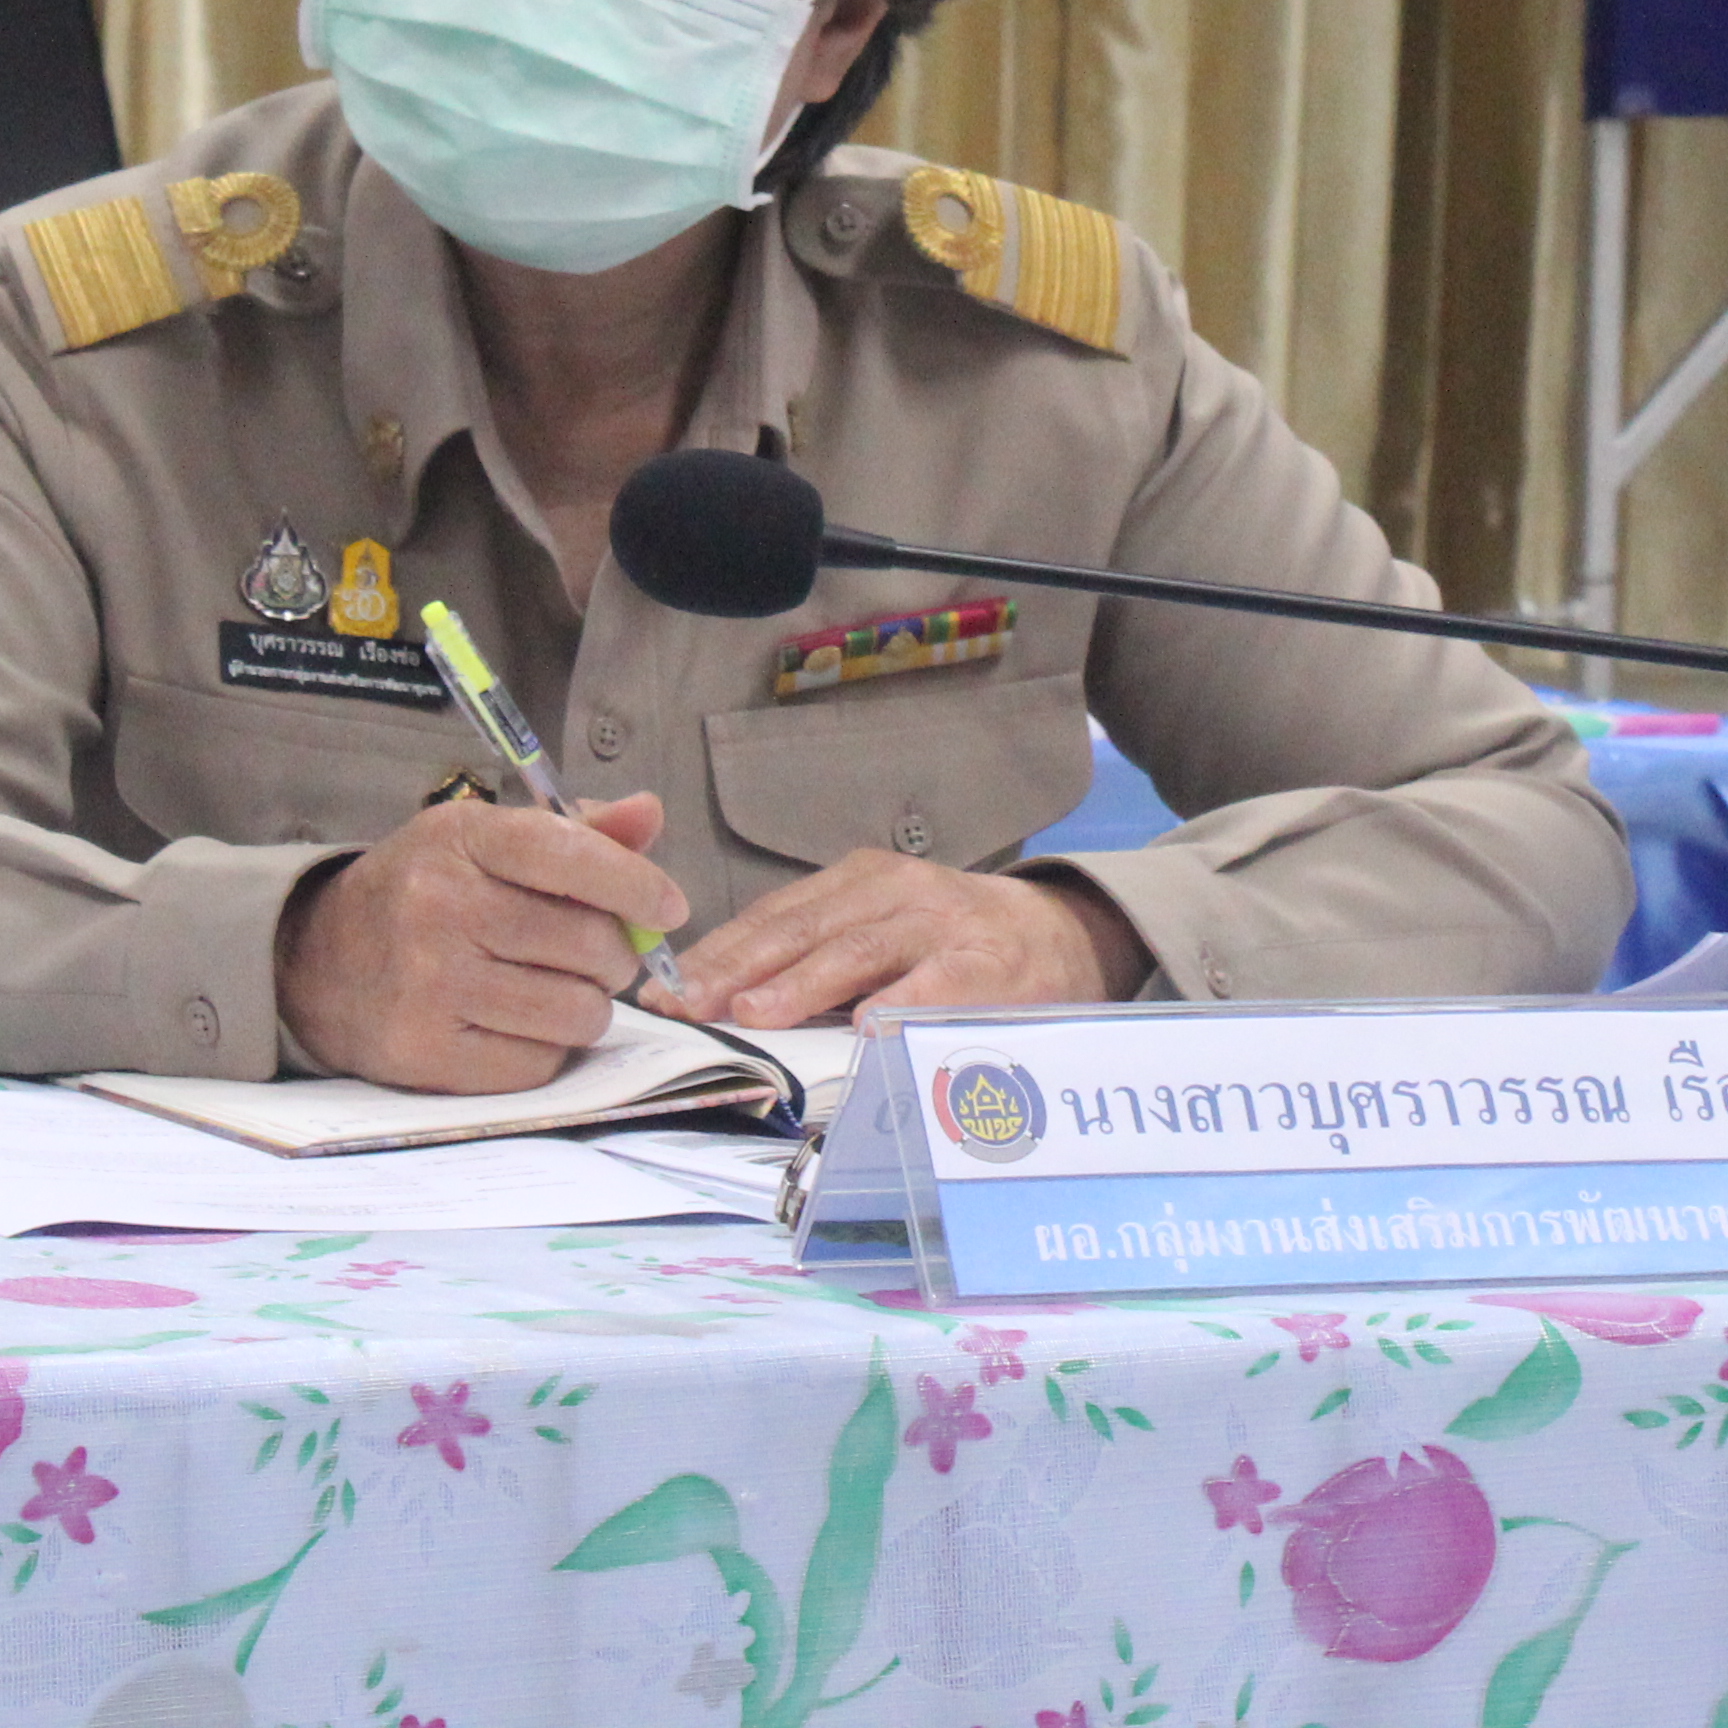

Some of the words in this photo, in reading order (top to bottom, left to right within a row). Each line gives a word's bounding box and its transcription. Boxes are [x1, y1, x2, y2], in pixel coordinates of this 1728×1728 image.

[1060, 1074, 1631, 1155] นางสาวบุศราวรรณ
